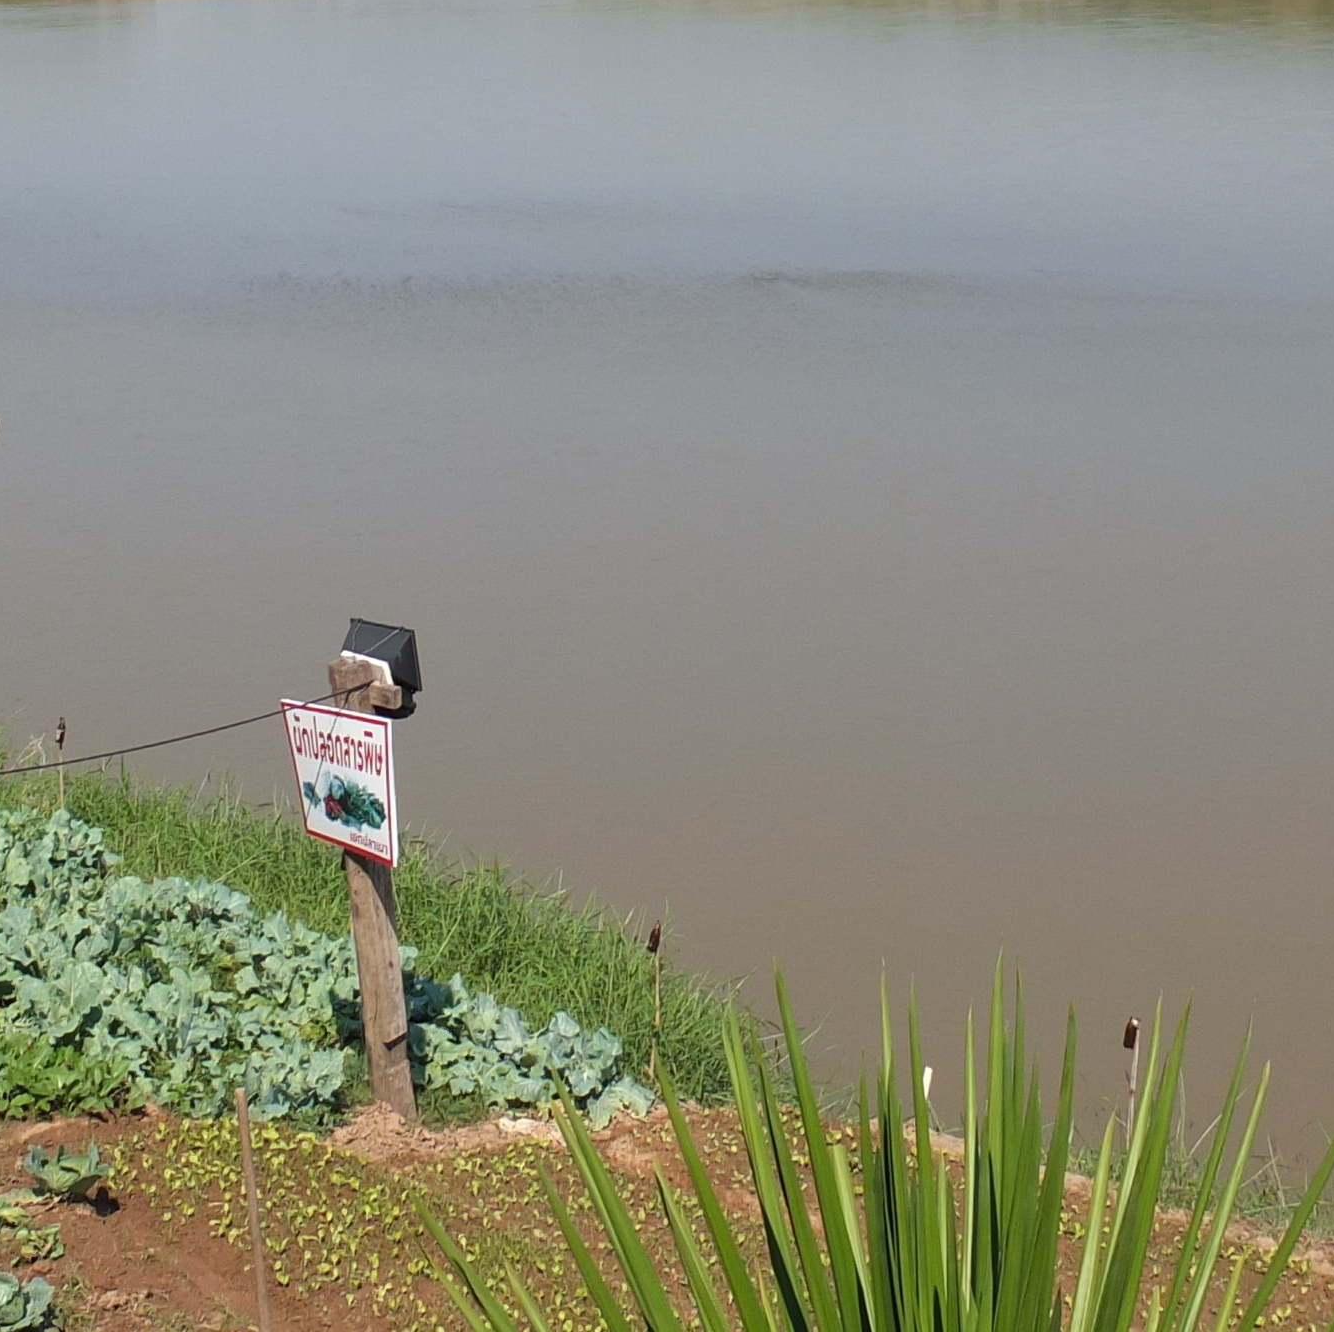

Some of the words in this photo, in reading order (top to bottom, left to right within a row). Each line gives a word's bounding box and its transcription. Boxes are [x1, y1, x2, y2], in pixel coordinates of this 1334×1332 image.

[293, 713, 383, 776] ผักปลอดสารพิษ
